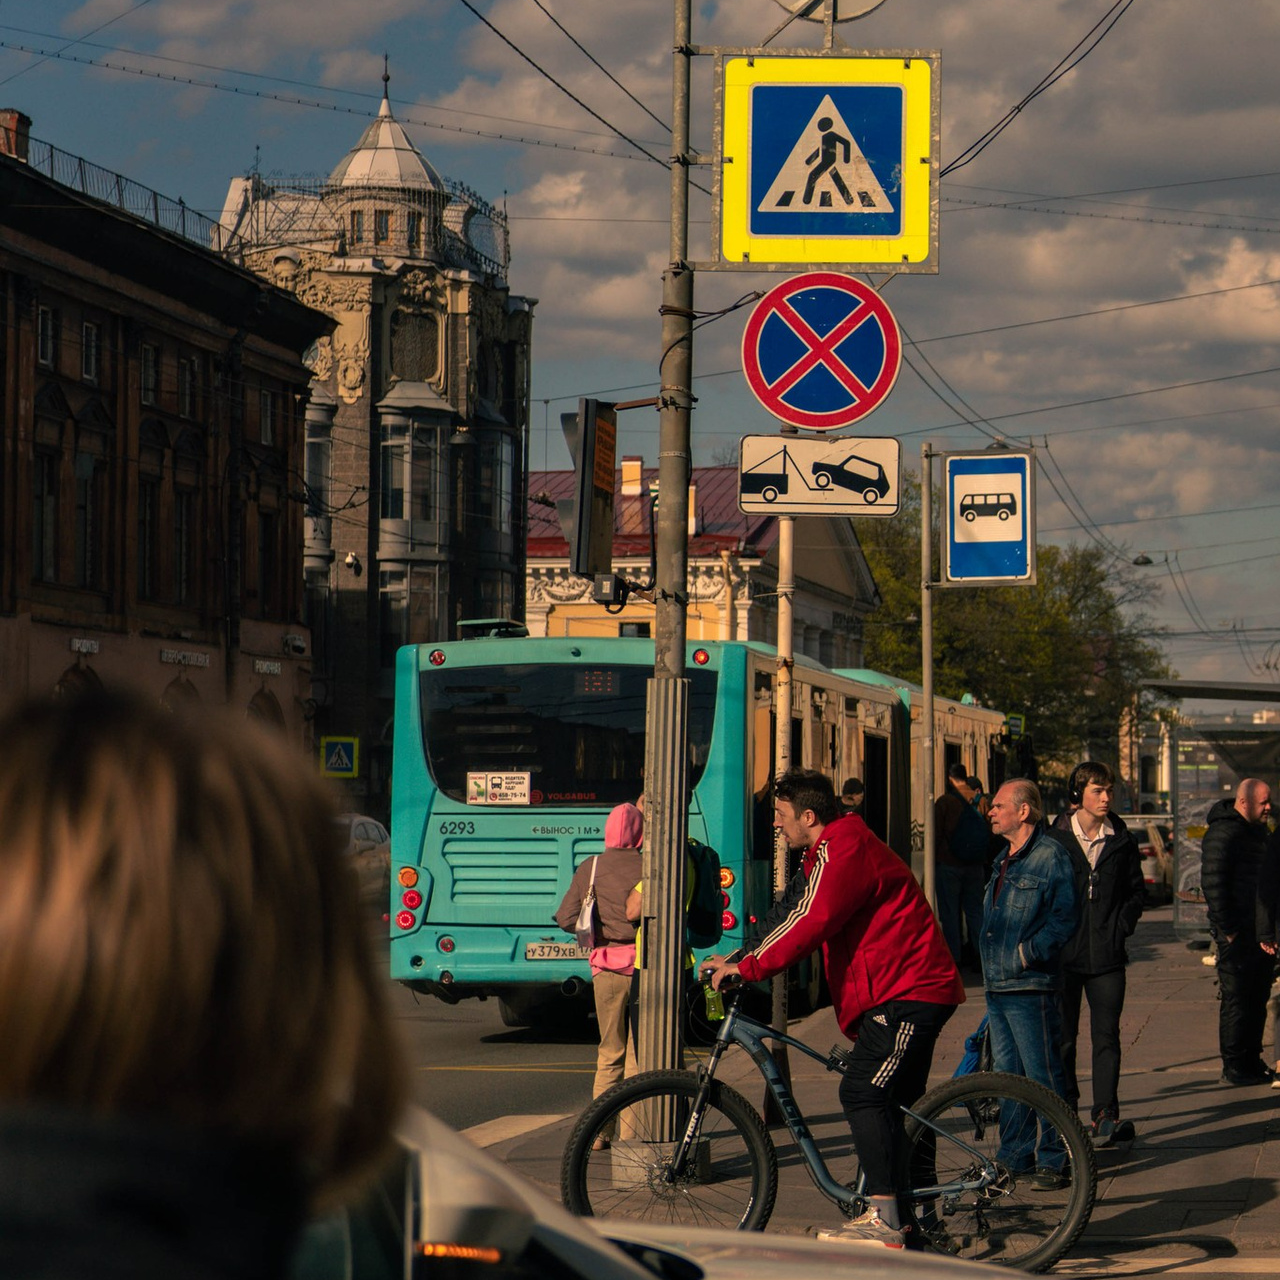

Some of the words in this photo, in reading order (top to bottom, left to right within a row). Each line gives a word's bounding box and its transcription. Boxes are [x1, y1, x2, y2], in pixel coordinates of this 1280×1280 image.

[547, 792, 597, 800] VOLGABUS
[439, 821, 475, 835] 6293
[540, 826, 574, 835] ВЫНОС
